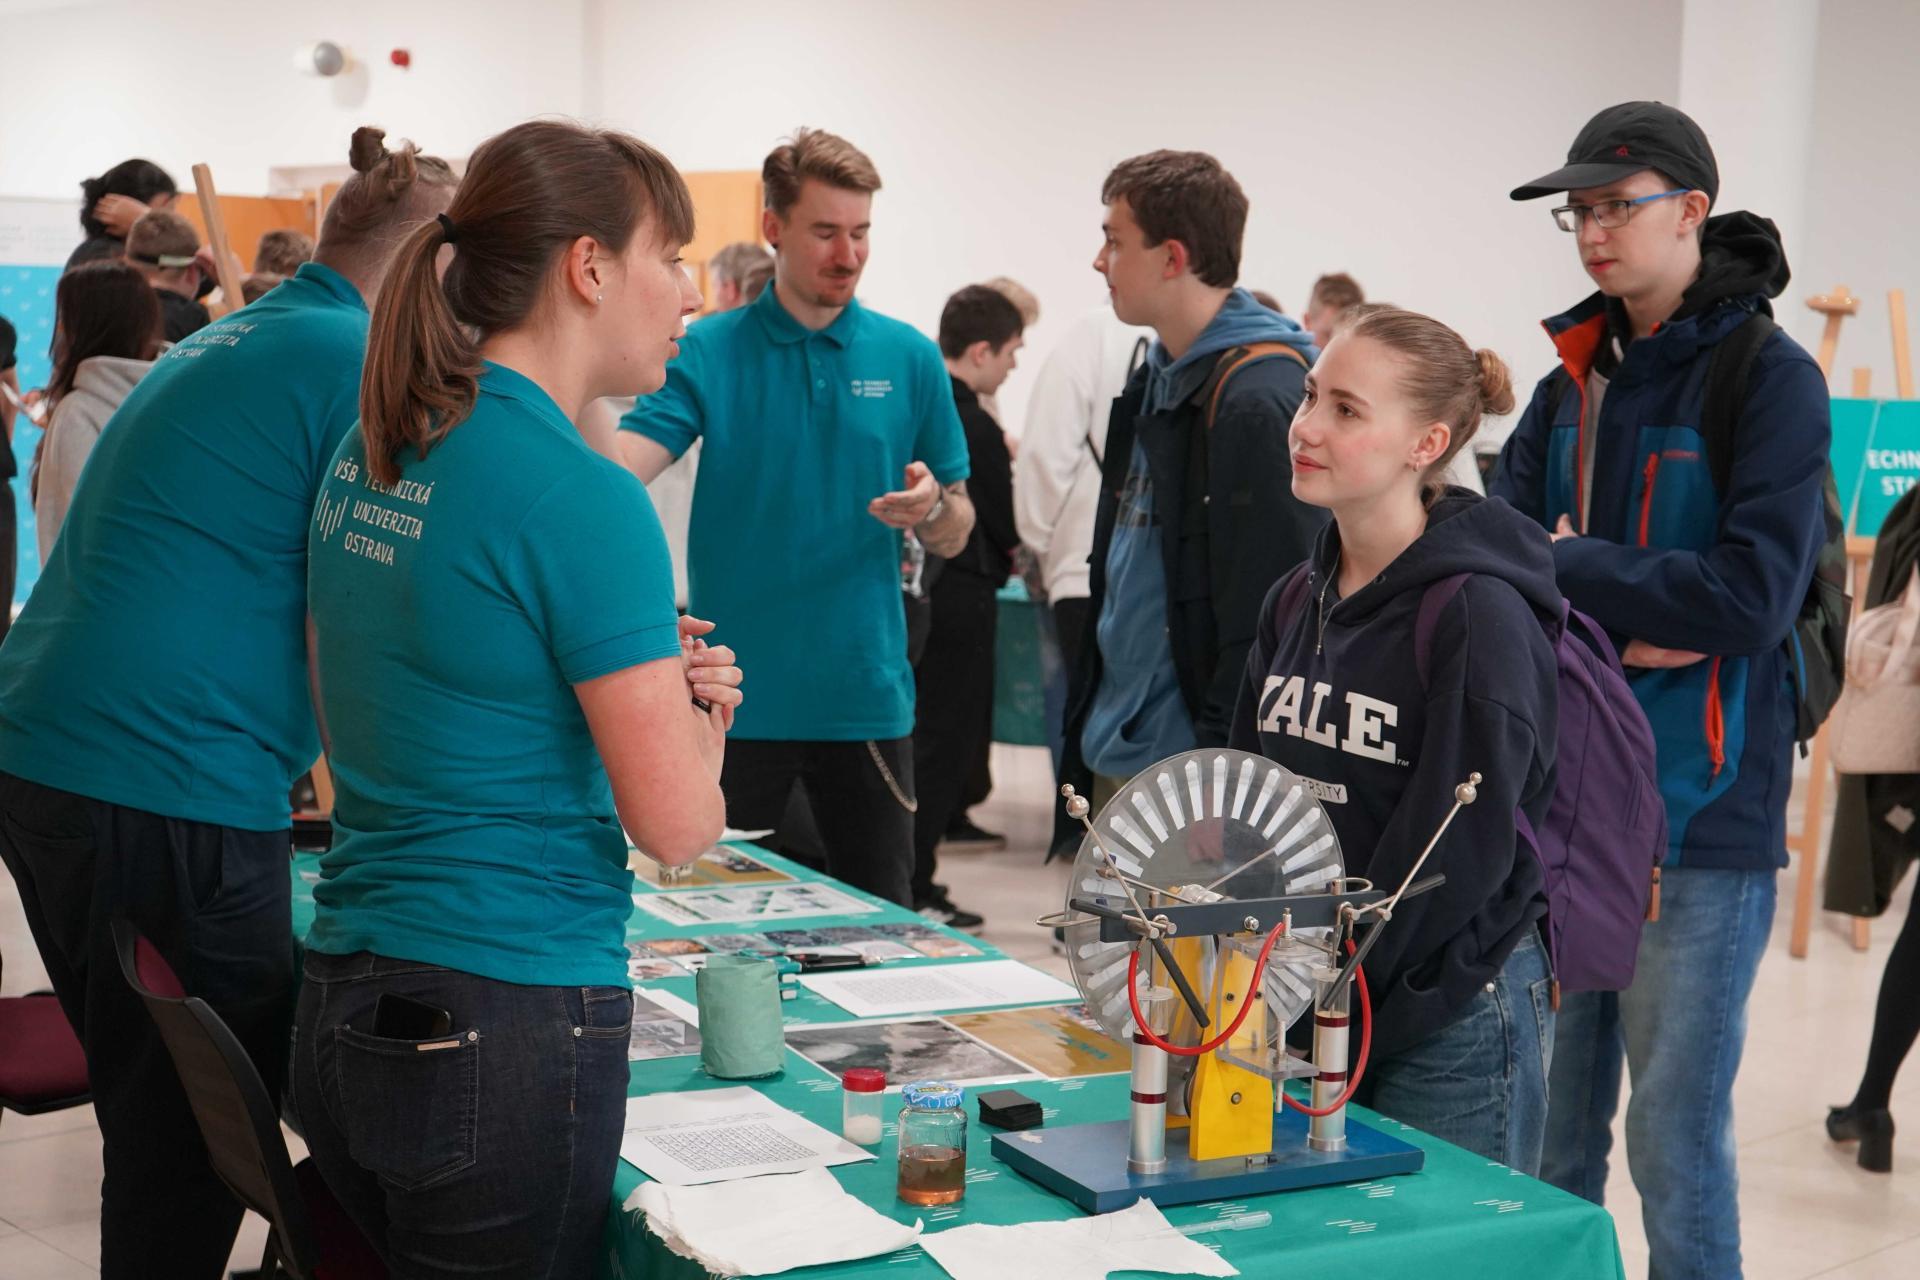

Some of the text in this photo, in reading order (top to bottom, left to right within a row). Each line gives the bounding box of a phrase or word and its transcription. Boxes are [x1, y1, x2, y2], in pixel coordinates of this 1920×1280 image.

[334, 457, 359, 483] VŠB
[353, 500, 423, 540] UNIVERZITA
[344, 531, 394, 566] OSTRAVA
[1302, 778, 1342, 800] RSITY
